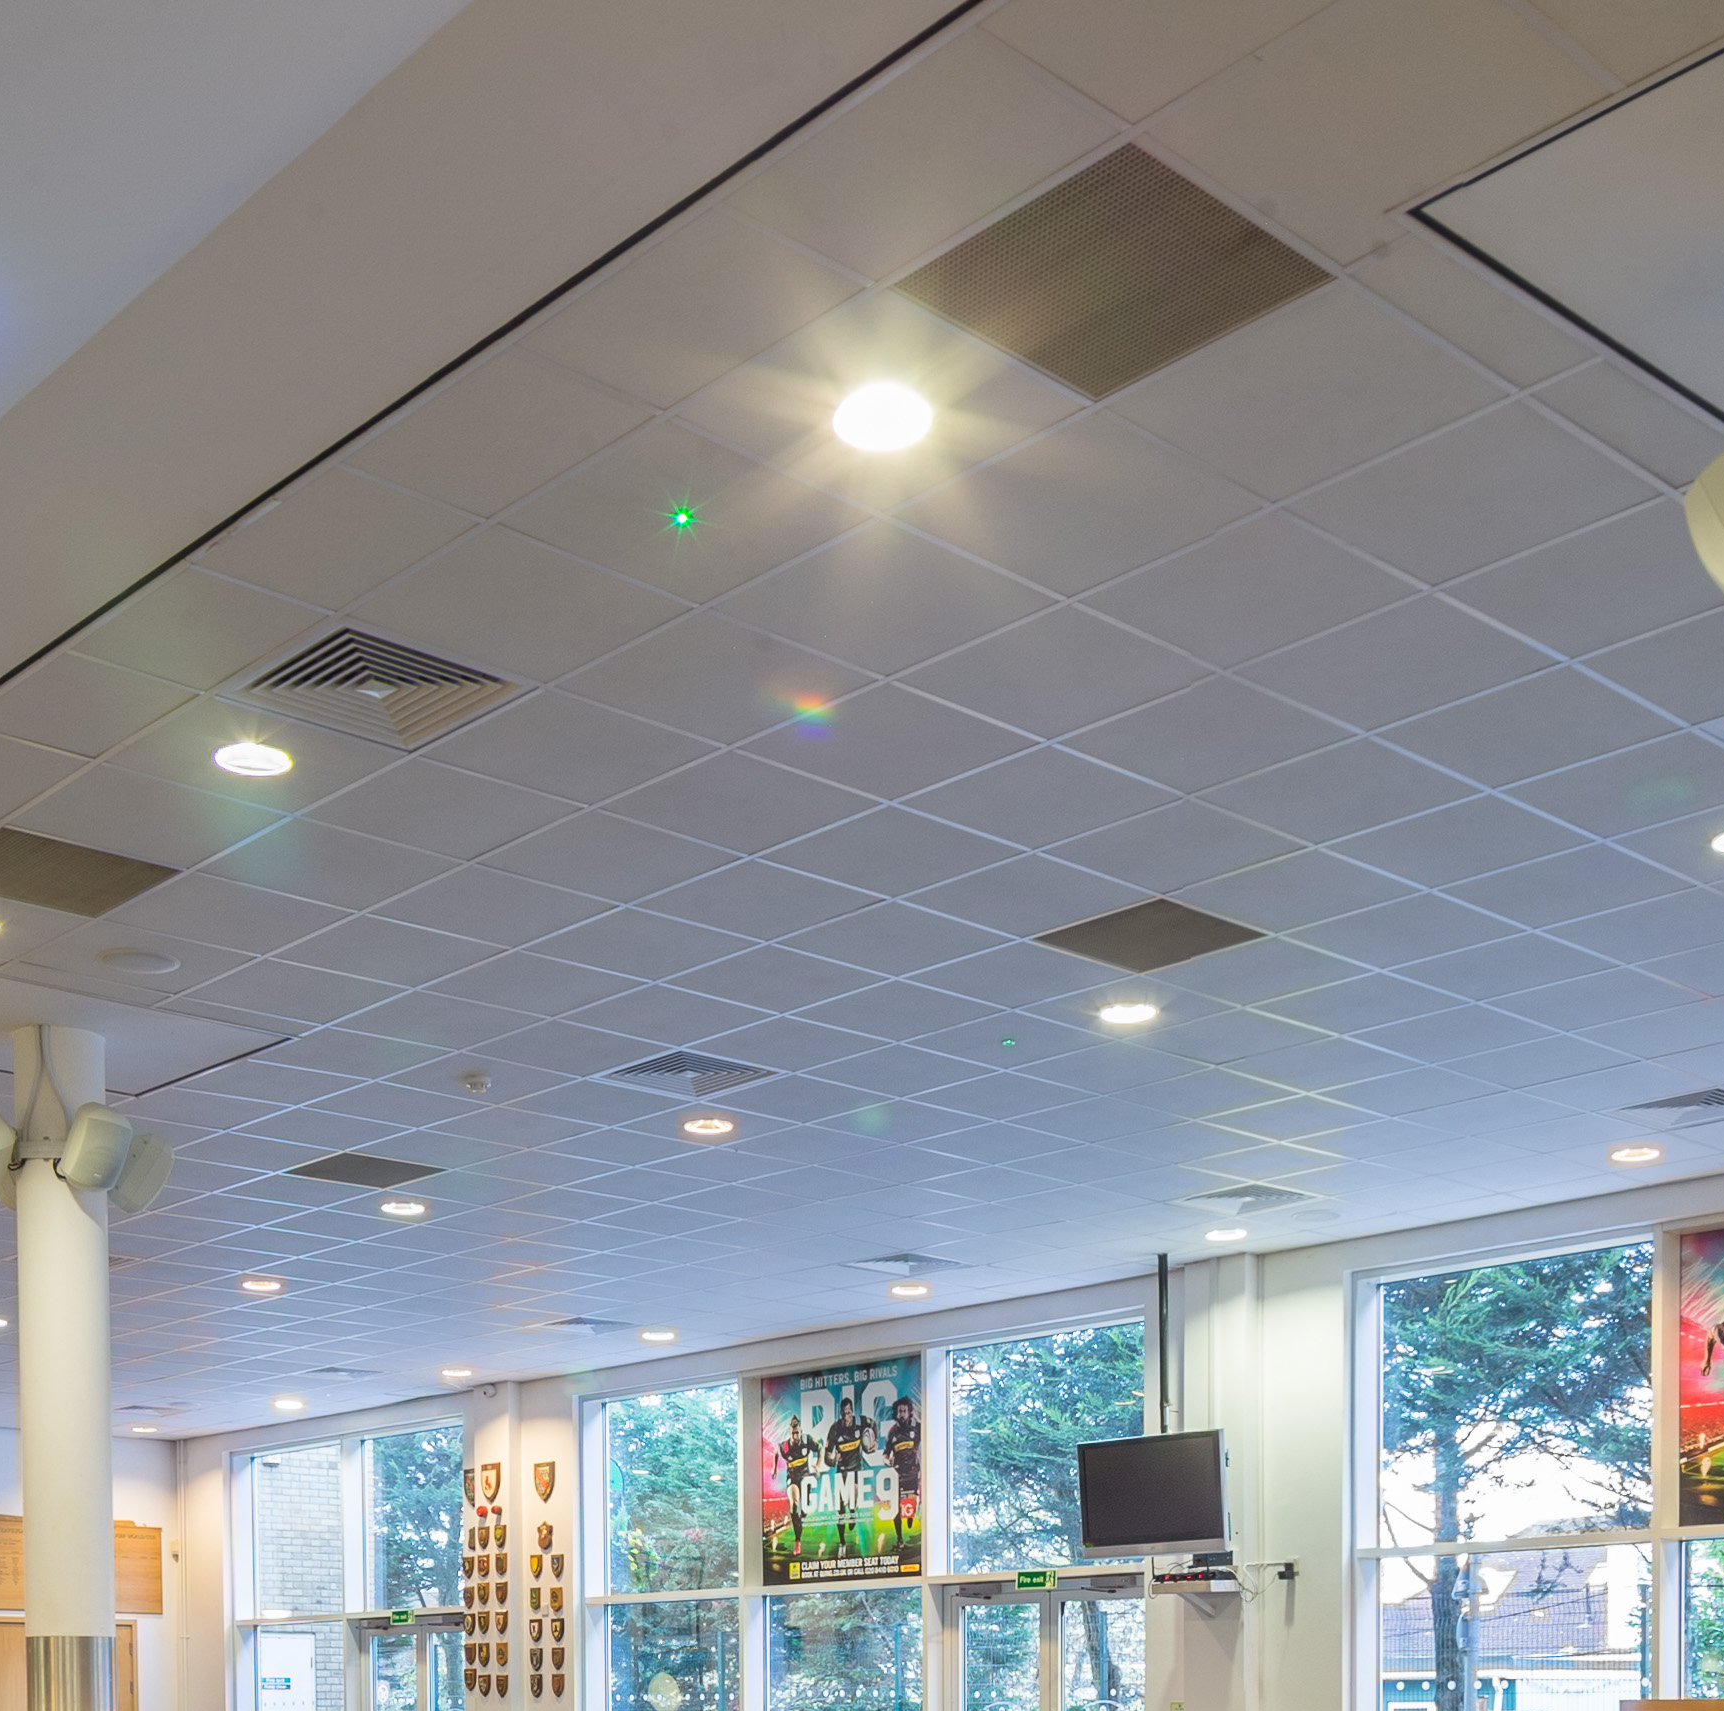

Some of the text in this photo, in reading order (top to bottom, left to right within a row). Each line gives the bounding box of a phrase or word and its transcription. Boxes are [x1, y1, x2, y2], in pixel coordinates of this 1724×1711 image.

[800, 1365, 898, 1390] BIG HITTERS, BIG RIVALS
[801, 1467, 900, 1521] GAME 9
[901, 1502, 914, 1518] IG
[880, 1555, 900, 1566] TODAY
